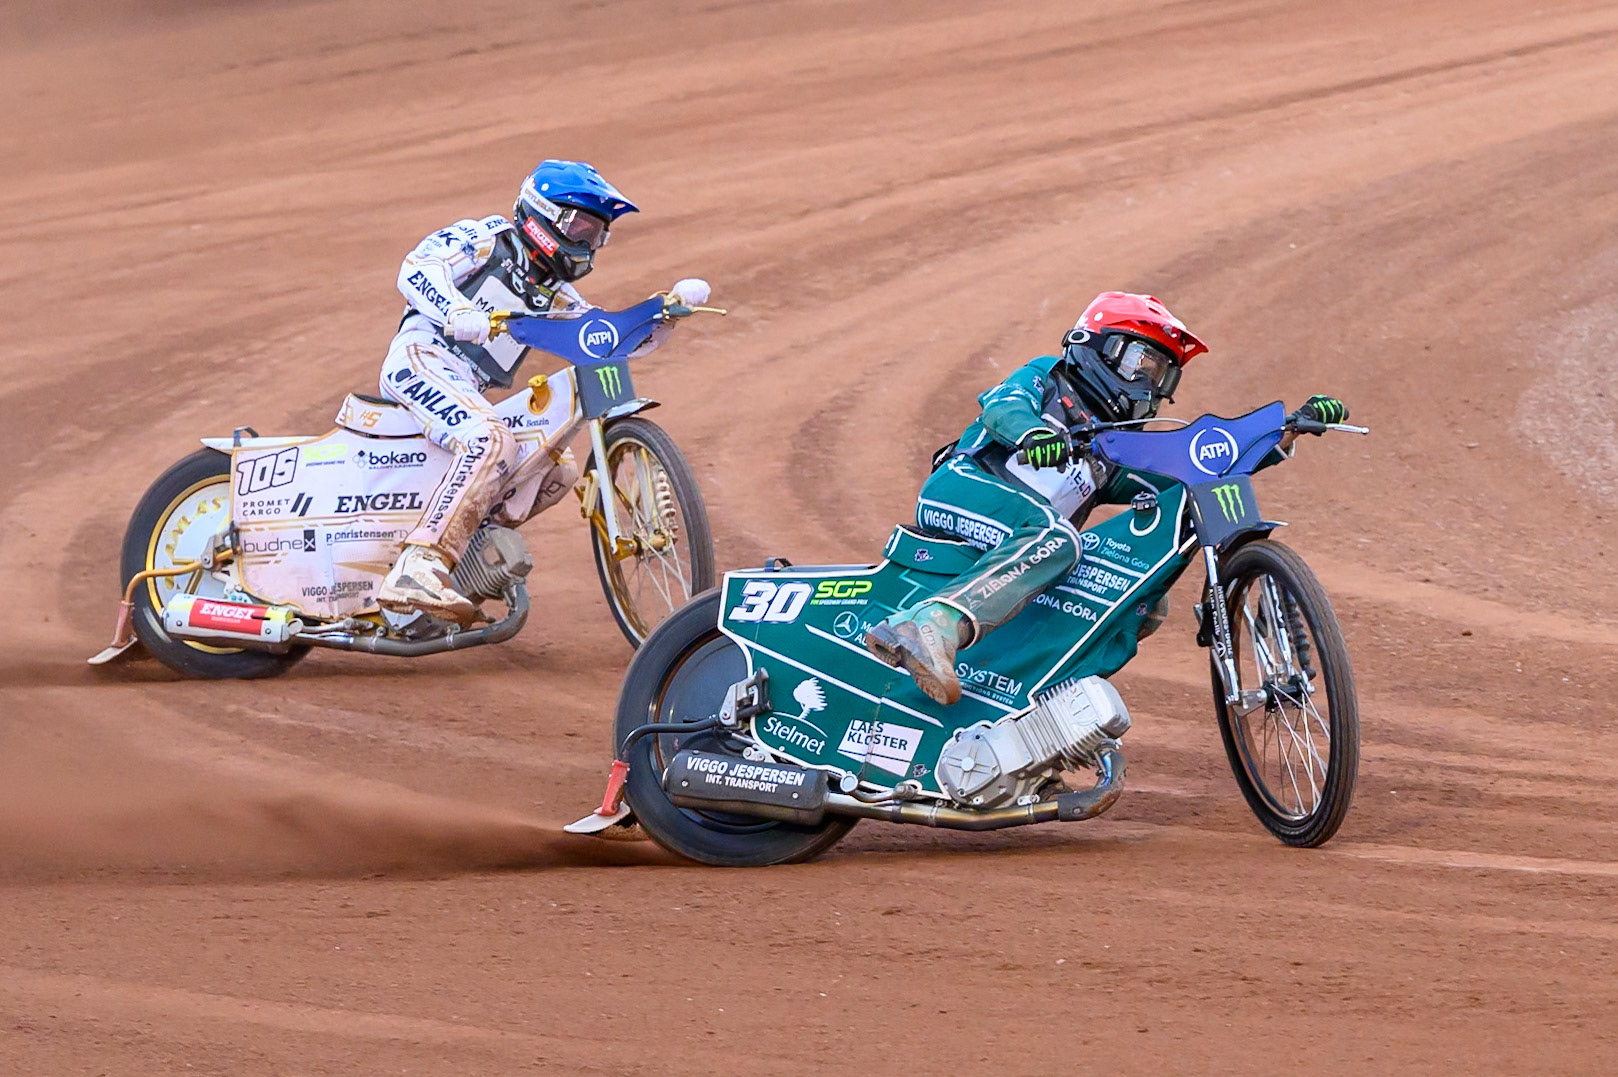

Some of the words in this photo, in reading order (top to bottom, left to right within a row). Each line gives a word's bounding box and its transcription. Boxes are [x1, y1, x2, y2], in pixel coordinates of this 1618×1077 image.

[407, 270, 451, 317] ENGEL
[586, 330, 612, 347] ATPI
[403, 380, 468, 427] ANLAS
[369, 451, 427, 465] bokaro
[1200, 442, 1230, 462] ATPI
[242, 498, 291, 508] PROMET
[242, 507, 281, 516] CARGO
[334, 492, 423, 514] ENGEL
[924, 509, 954, 531] VIGGO
[955, 516, 1005, 548] JESPERSEN
[243, 529, 316, 553] budnex
[1105, 537, 1132, 553] Toyota
[977, 561, 1031, 599] ZIELONA
[1029, 537, 1067, 565] GÓRA
[1100, 546, 1130, 563] Zielona
[1131, 557, 1150, 570] Góra
[1072, 564, 1132, 592] JESPERSEN
[302, 585, 328, 597] VIGGO
[814, 580, 873, 598] SGP
[200, 602, 256, 620] ENGEL
[728, 579, 814, 624] 30
[1062, 601, 1097, 622] GÓRA
[955, 662, 1023, 697] SYSTEM
[763, 715, 826, 757] Stelmet
[847, 731, 908, 751] KLOSTER
[687, 756, 728, 776] VIGGO
[729, 761, 806, 787] JESPERSEN
[705, 773, 723, 785] INT.
[723, 775, 778, 794] TRANSPORT
